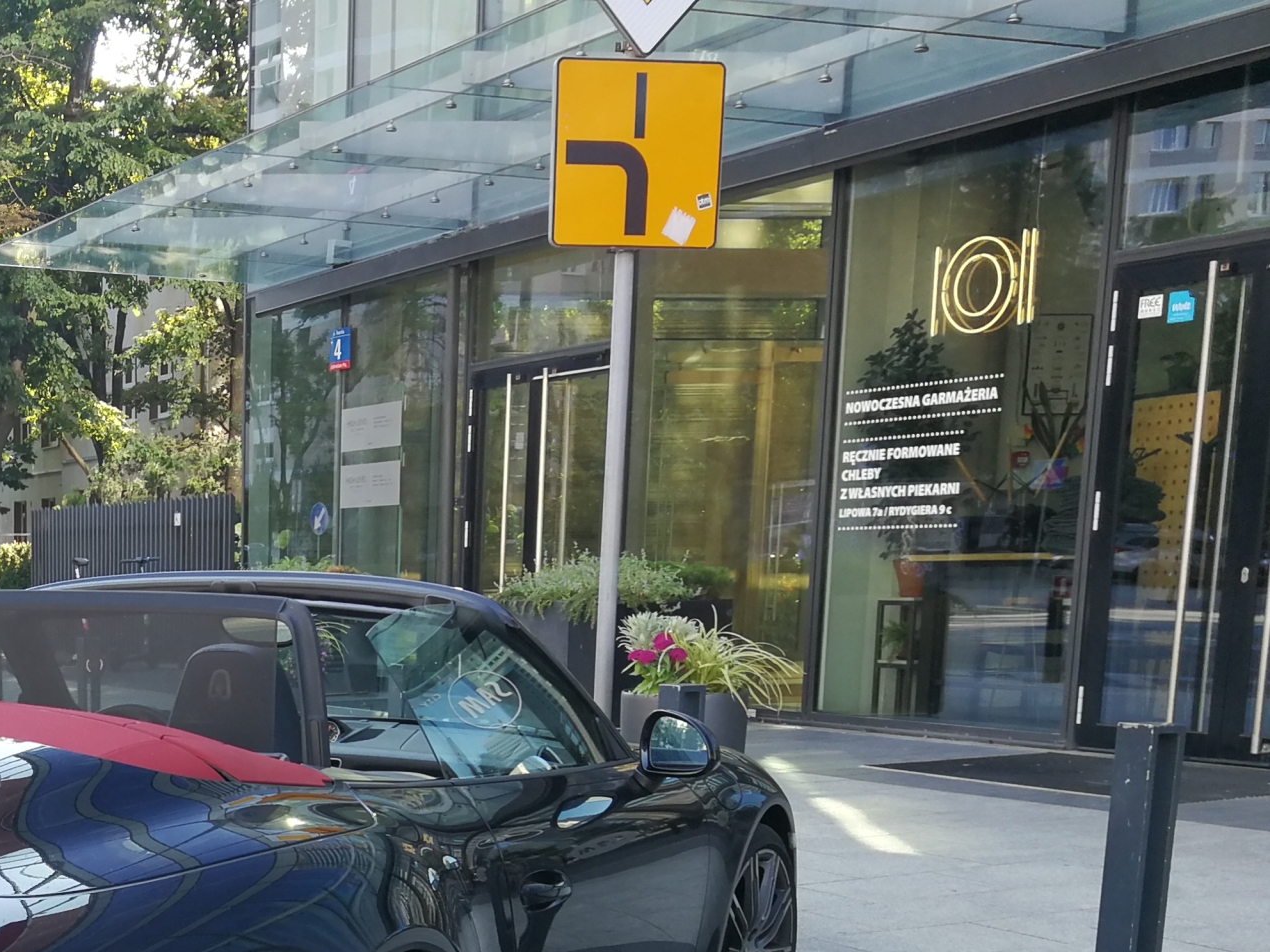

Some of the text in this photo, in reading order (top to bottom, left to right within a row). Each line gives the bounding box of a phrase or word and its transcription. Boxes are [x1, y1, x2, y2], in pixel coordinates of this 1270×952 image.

[333, 338, 343, 360] 4
[845, 386, 999, 414] NOWOCZESNA GARMAŻERIA
[842, 443, 961, 466] RĘCZNIE FORMOWANE
[841, 467, 882, 482] CHLEBY
[840, 482, 960, 500] Z WŁASNYCH PIEKARNI
[838, 507, 871, 518] LIPOWA
[872, 507, 883, 517] 7a
[888, 505, 938, 516] RYDYGIERA
[938, 504, 946, 515] 9
[946, 506, 953, 515] c
